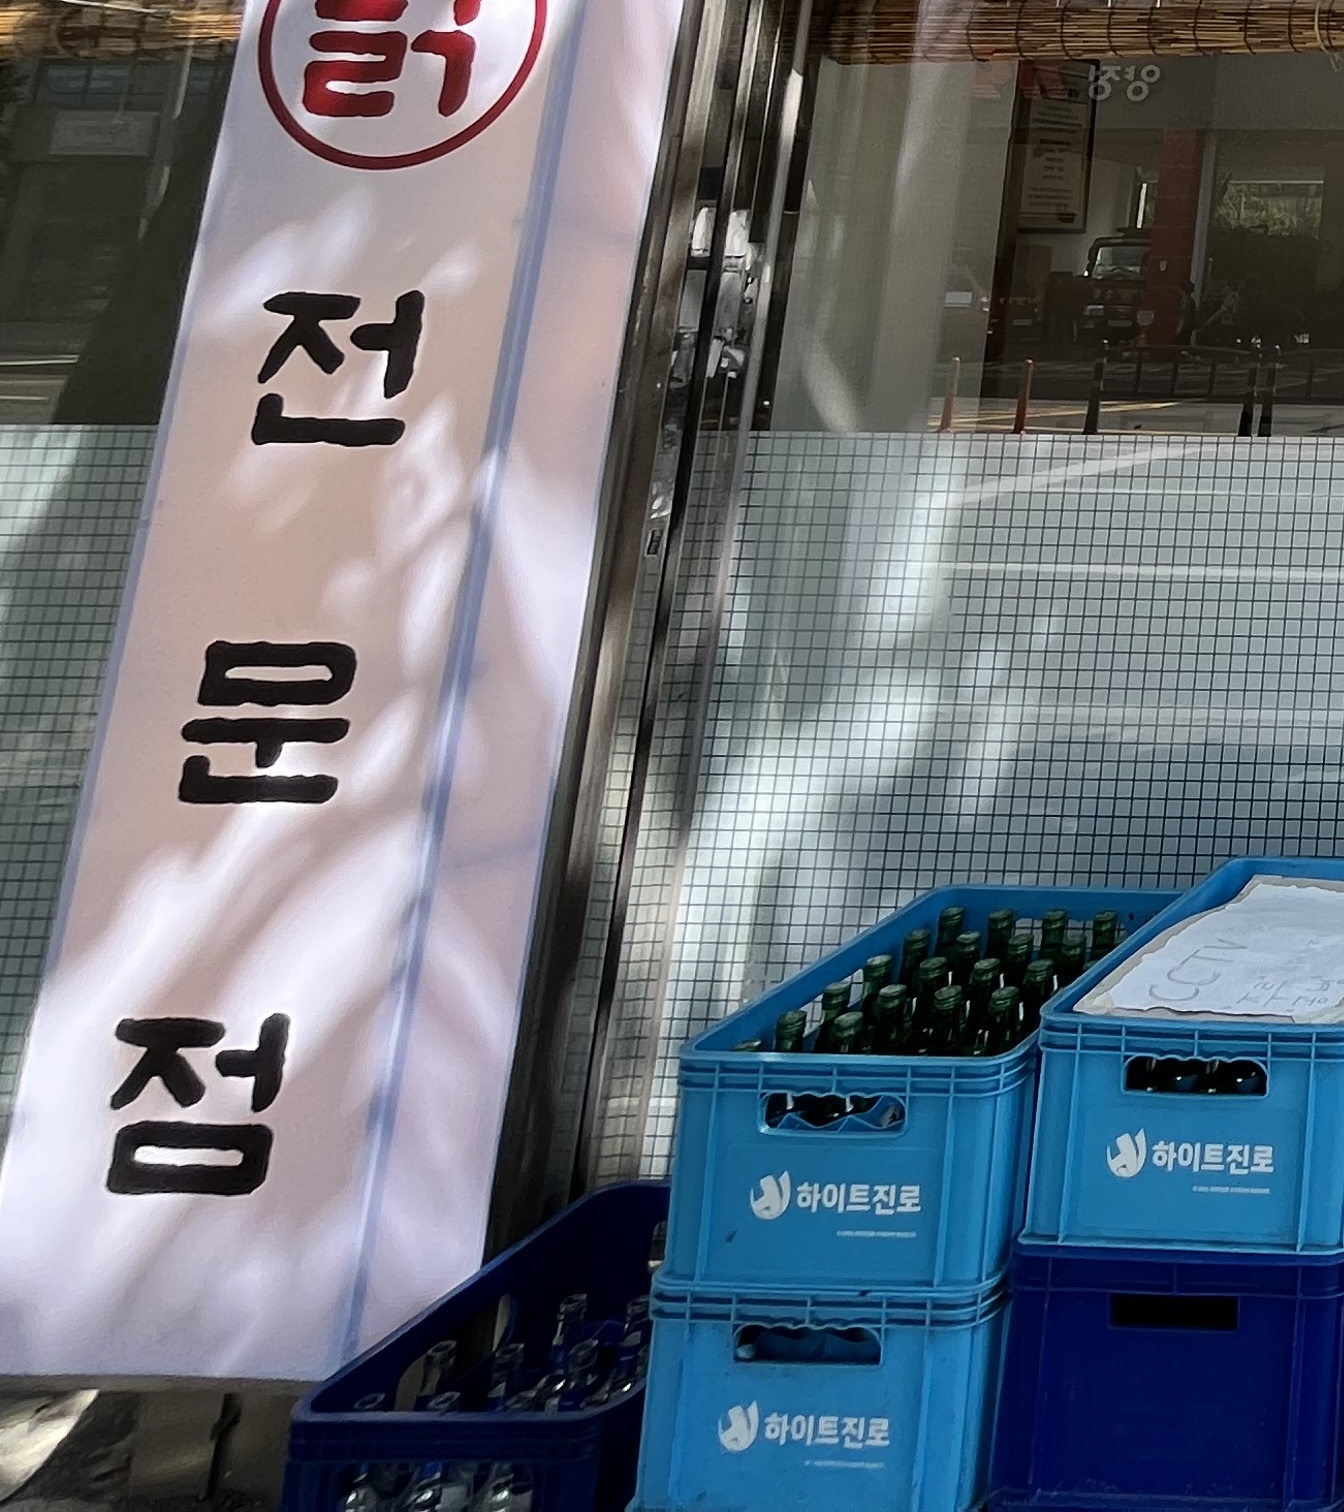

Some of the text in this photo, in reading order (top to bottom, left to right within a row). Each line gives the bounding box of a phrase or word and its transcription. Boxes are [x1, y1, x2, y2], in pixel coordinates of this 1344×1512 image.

[105, 290, 425, 1195] 전문점
[1151, 1140, 1275, 1175] 하이트진로
[796, 1182, 921, 1215] 하이트진로
[764, 1412, 890, 1449] 하이트진로
